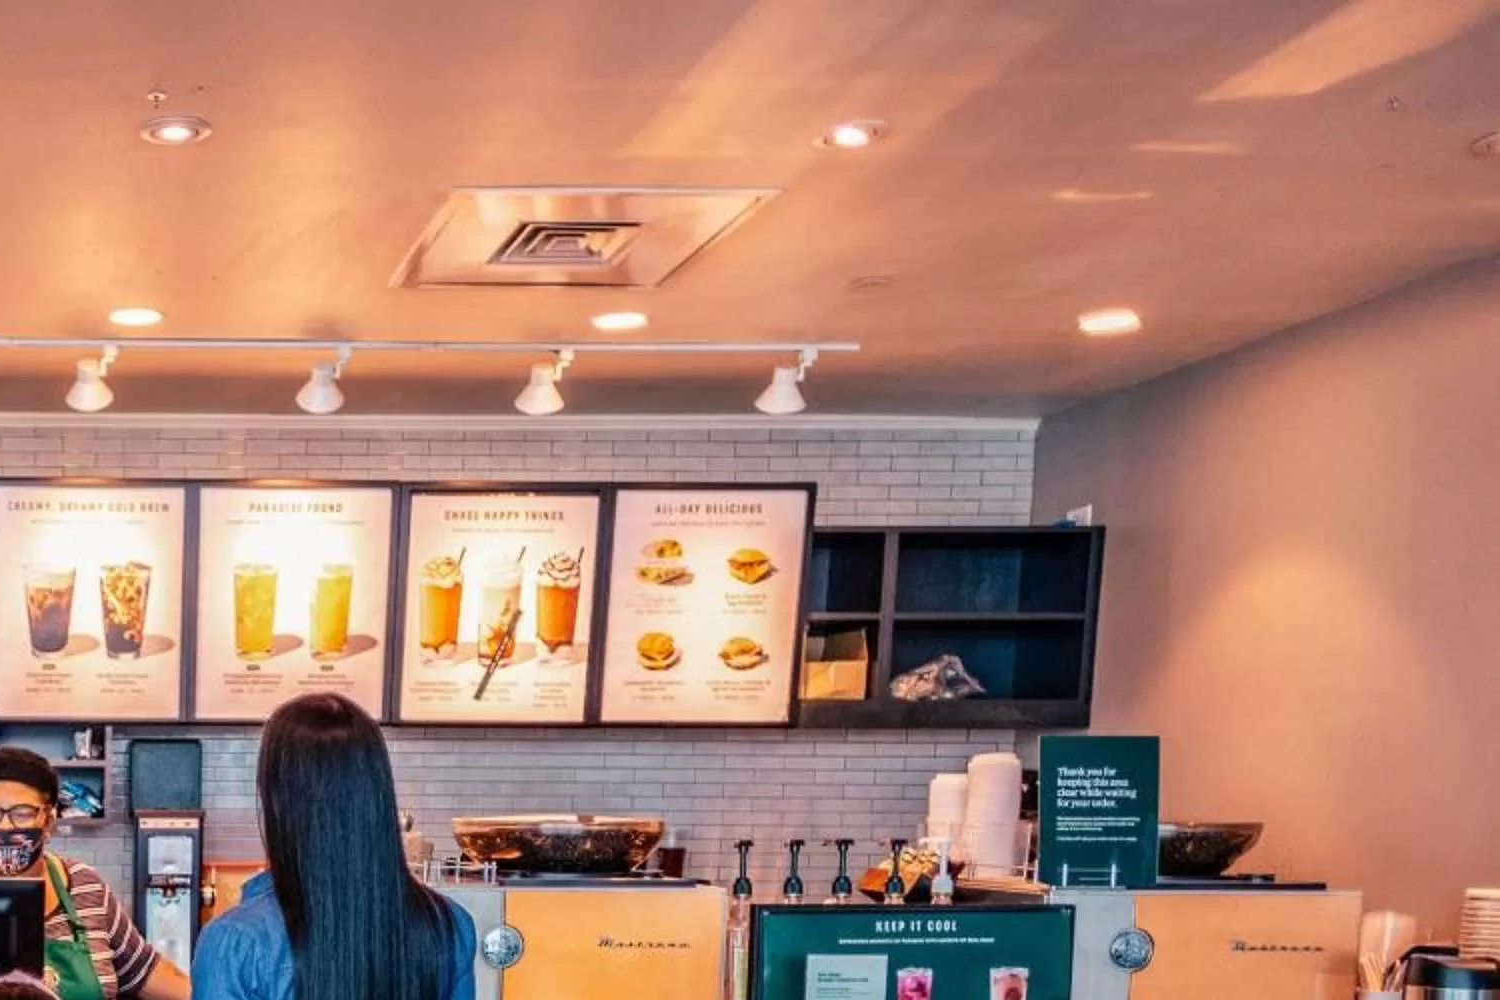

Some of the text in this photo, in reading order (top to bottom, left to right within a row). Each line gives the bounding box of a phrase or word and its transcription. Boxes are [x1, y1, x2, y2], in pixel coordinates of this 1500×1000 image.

[107, 501, 135, 512] COLD
[140, 501, 170, 512] BREW
[307, 502, 343, 512] FOUND
[705, 503, 763, 514] DELICIOUS
[484, 510, 520, 521] HAPPY
[525, 510, 565, 521] THINGS
[1057, 766, 1117, 778] Thank you for
[1057, 777, 1129, 789] keeping this area
[1057, 788, 1137, 799] clear while waiting
[1057, 798, 1069, 808] for
[1069, 799, 1090, 809] your
[875, 920, 957, 933] KEEP IT COOL
